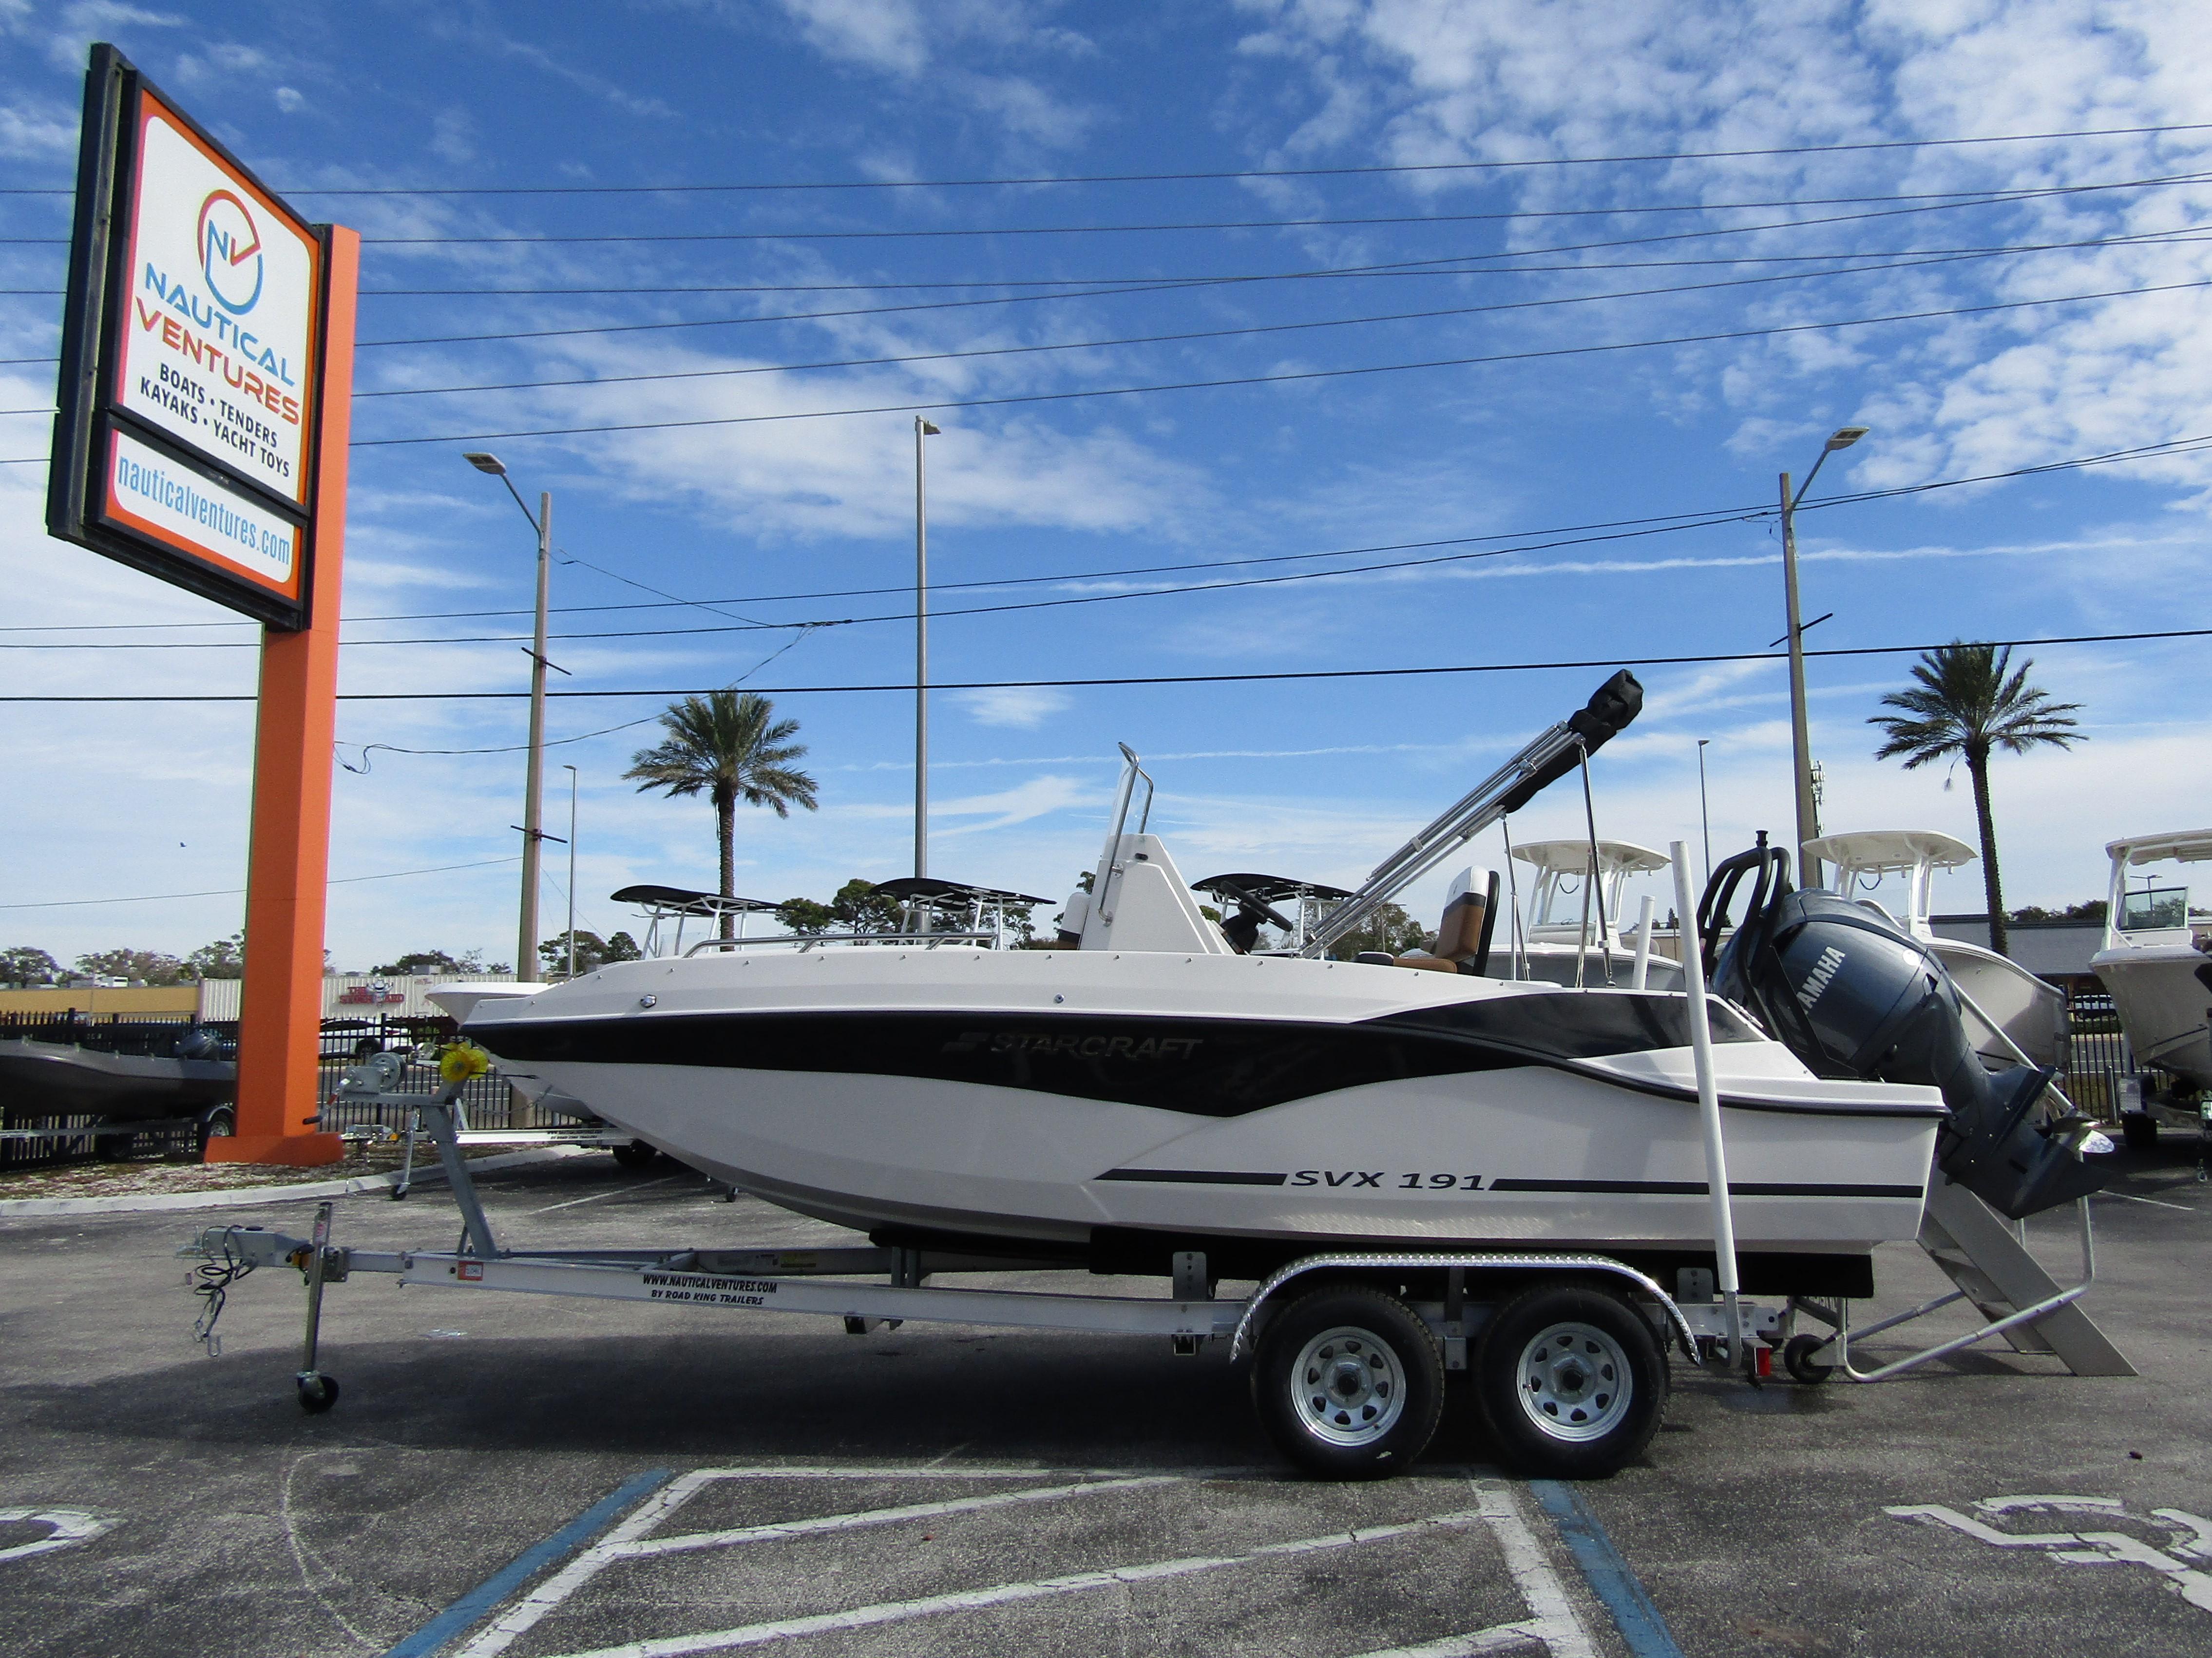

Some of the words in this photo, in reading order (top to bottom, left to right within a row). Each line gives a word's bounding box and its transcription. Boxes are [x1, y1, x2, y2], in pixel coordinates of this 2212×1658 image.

[135, 295, 299, 425] VENTURES
[145, 262, 295, 387] NAUTICAL
[140, 376, 198, 424] KAYAKS
[213, 418, 256, 457] YACHT
[260, 446, 290, 478] TOYS
[160, 362, 205, 405] BOATS
[220, 399, 278, 449] TENDERS
[118, 456, 290, 565] nauticalventures.com
[990, 1032, 1204, 1061] STARCRAFT
[1290, 1170, 1385, 1188] SVX
[1397, 1173, 1485, 1191] 191
[643, 1274, 778, 1294] WWW.NAUTICALVENTURES.COM
[651, 1289, 663, 1298] BY
[665, 1290, 690, 1300] ROAD
[693, 1293, 716, 1302] KING
[720, 1294, 764, 1305] TRAILERS
